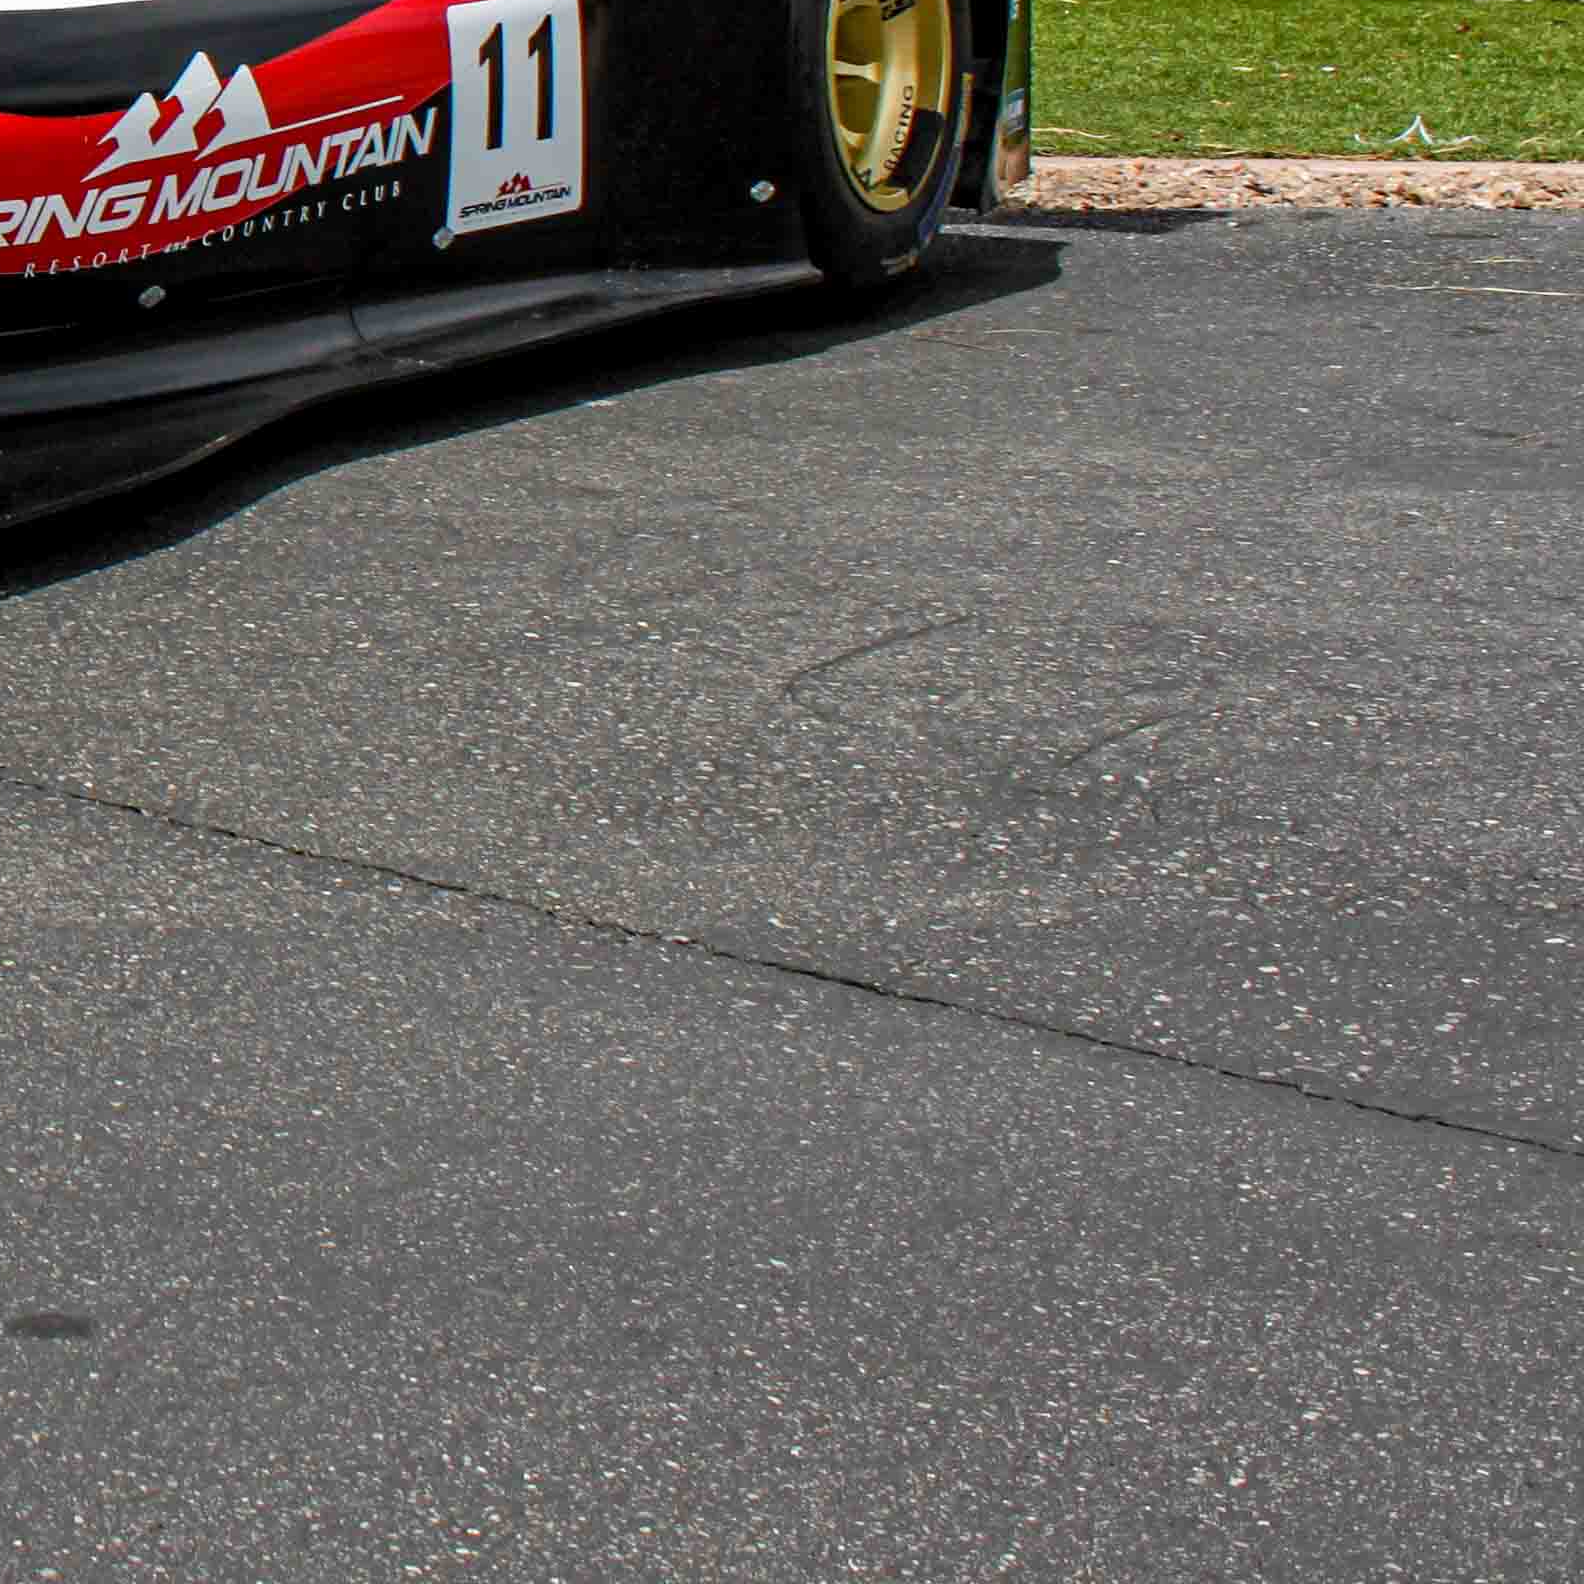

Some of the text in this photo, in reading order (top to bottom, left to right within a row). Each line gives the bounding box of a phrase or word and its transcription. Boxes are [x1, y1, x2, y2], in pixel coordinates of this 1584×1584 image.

[478, 13, 554, 151] 11
[882, 84, 915, 171] RACING
[147, 106, 438, 226] MOUNTAIN
[457, 198, 507, 219] SPRING
[505, 184, 573, 210] MOUNTAIN
[23, 242, 152, 280] RESORT
[162, 235, 194, 254] and
[201, 199, 329, 248] COUNTRY
[342, 179, 401, 211] CLUB
